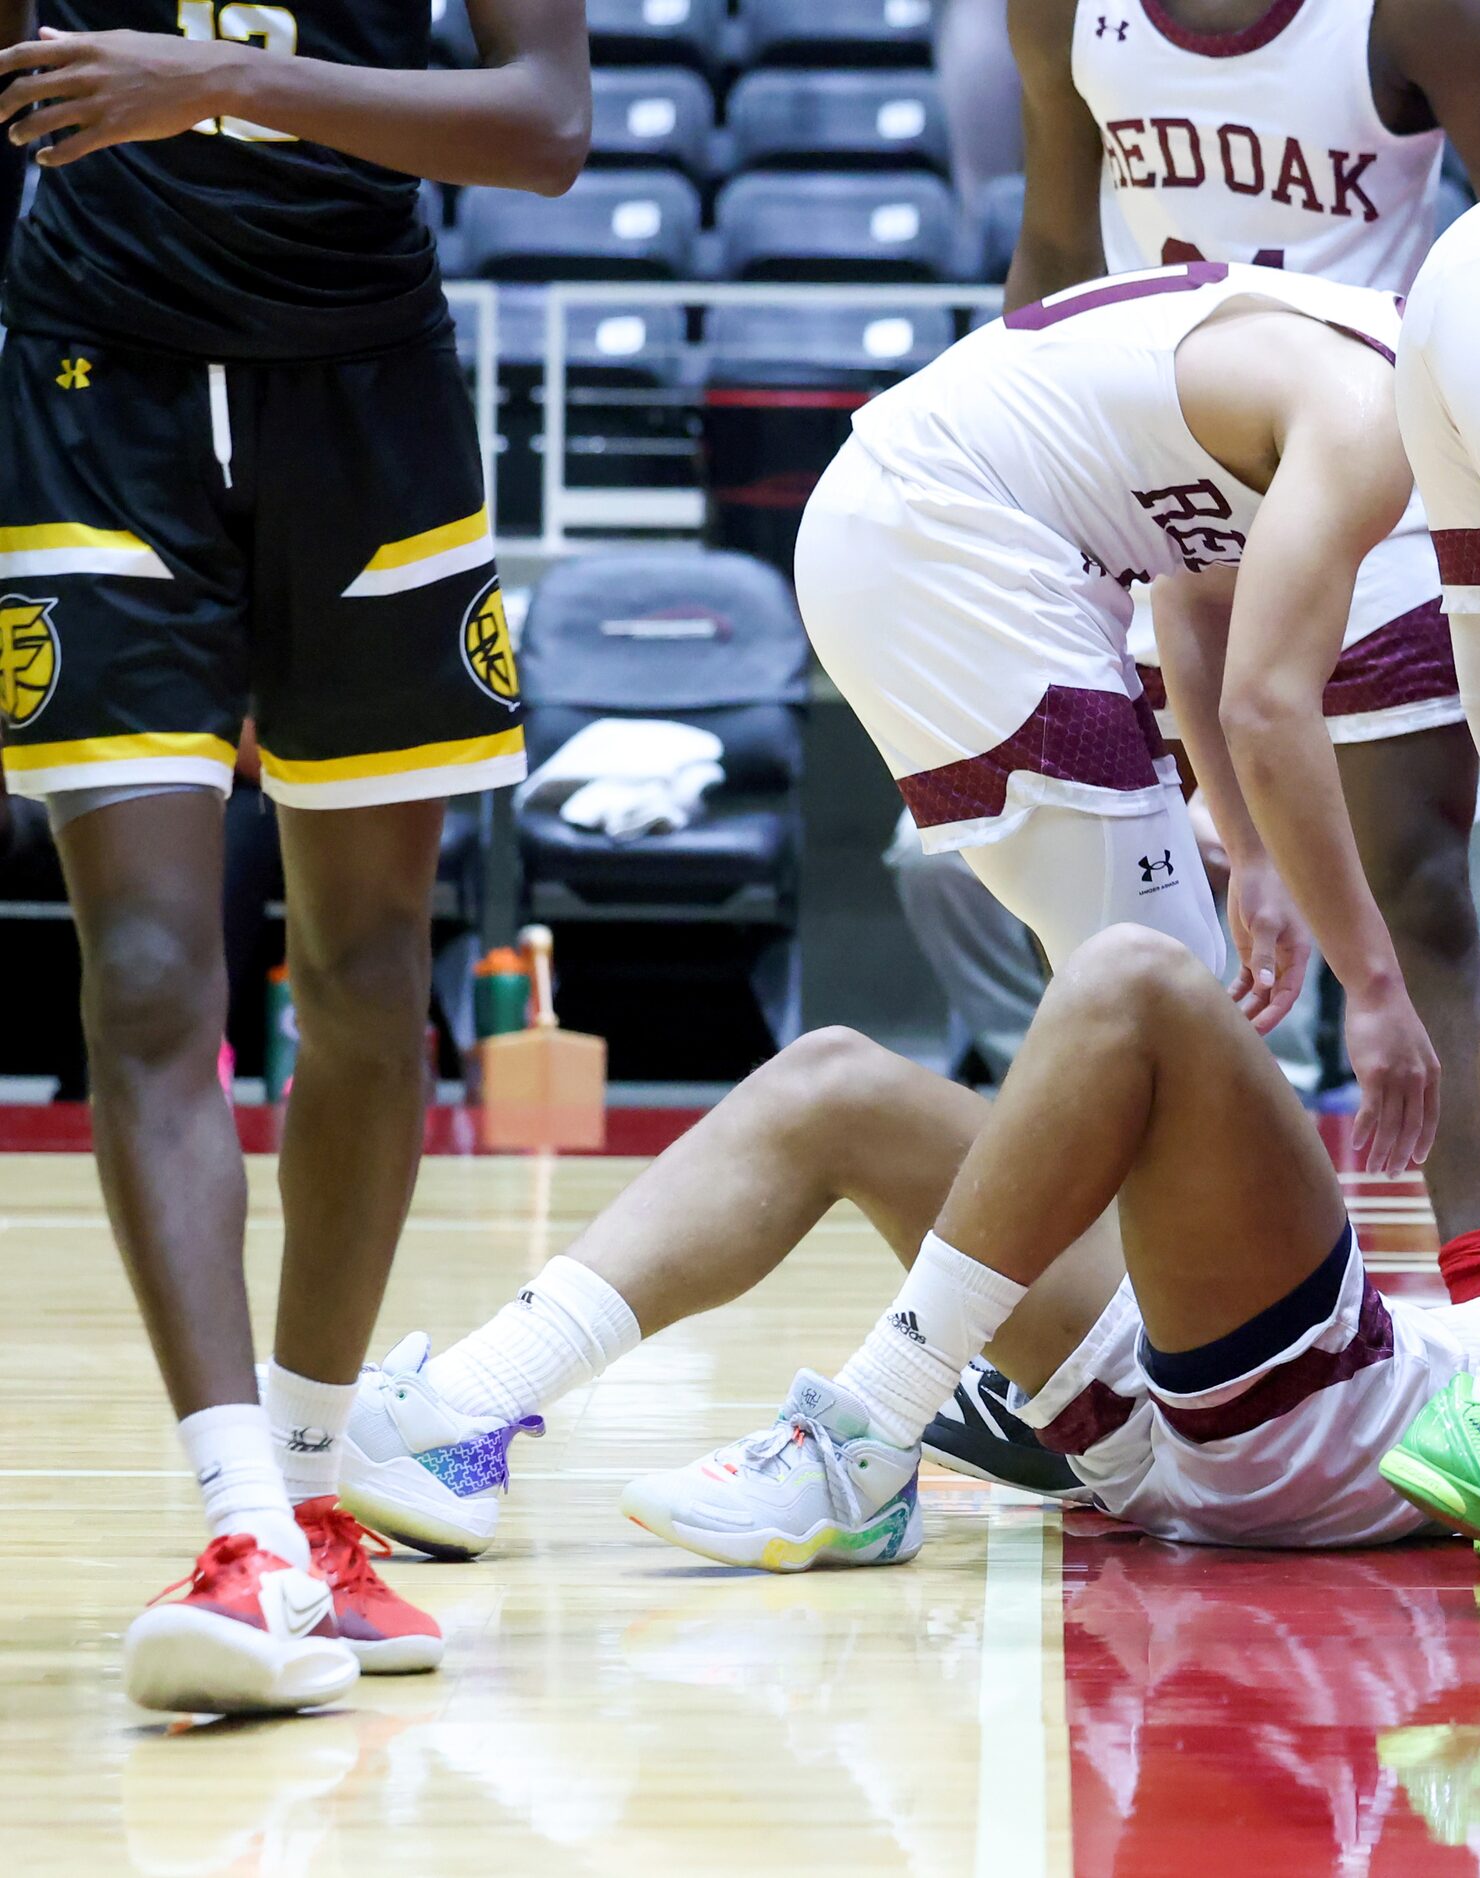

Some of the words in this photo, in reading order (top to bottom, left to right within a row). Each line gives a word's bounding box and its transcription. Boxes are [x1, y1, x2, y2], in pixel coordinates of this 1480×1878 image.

[1217, 123, 1379, 222] OAK
[1131, 479, 1246, 573] RE
[886, 1313, 927, 1345] adidas
